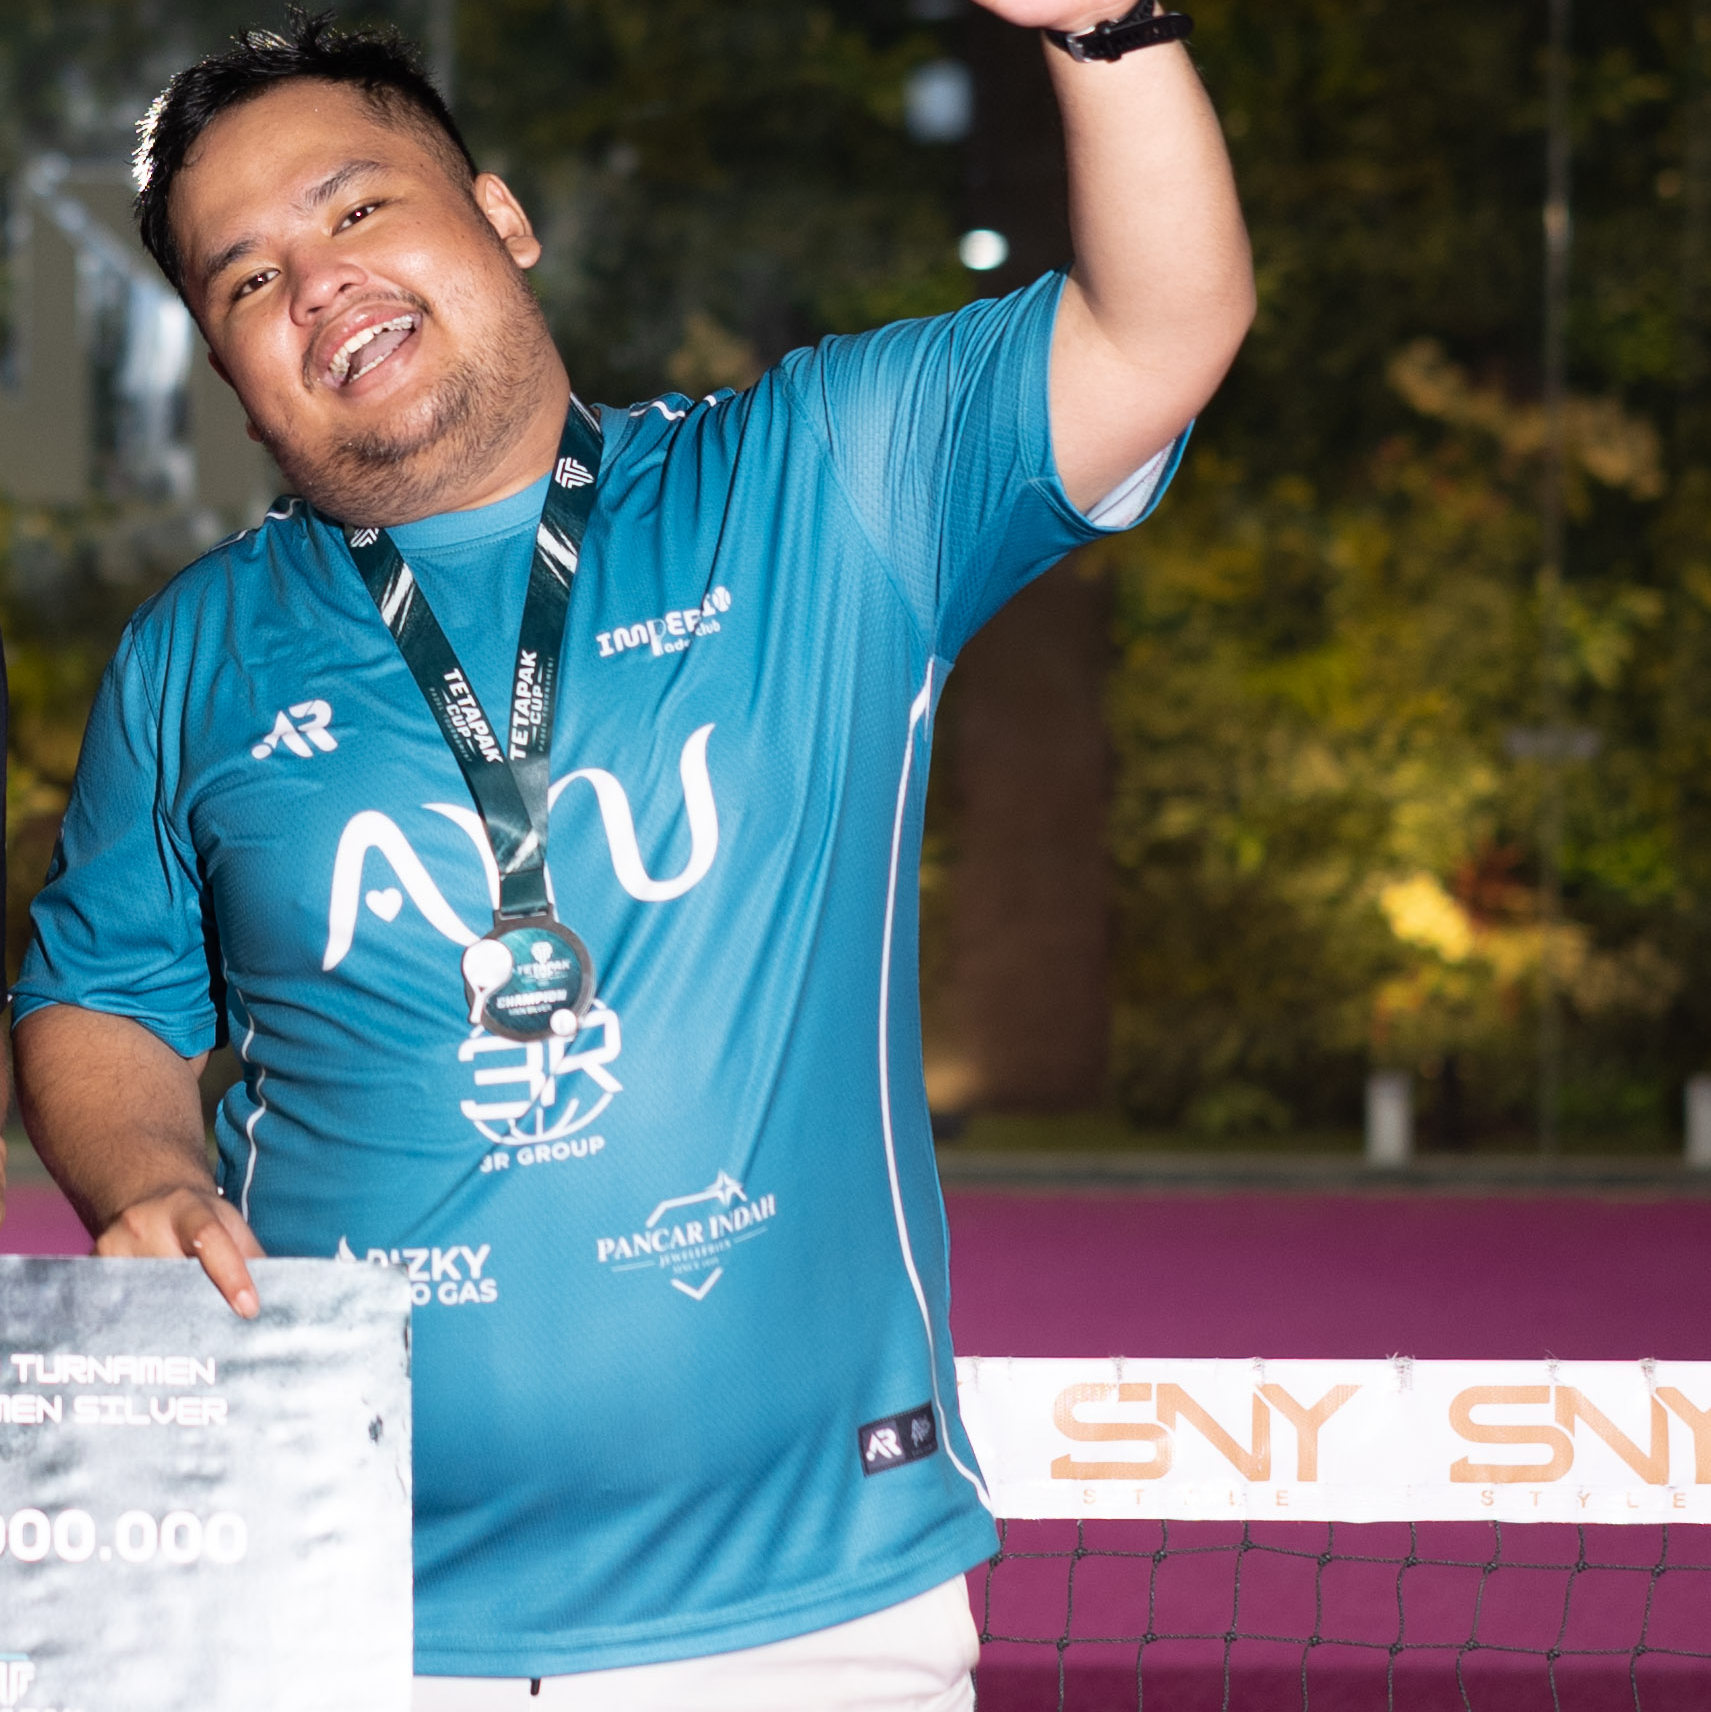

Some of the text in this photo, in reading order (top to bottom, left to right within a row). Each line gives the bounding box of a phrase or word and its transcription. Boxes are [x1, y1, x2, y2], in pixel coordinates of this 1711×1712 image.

[443, 668, 504, 763] TETAPAK
[510, 649, 537, 761] TETAPAK
[530, 684, 544, 725] CUP
[446, 704, 472, 739] CUP
[496, 989, 567, 1009] CHAMPION
[517, 1135, 605, 1166] GROUP
[596, 1193, 777, 1263] PANCAR INDAH
[439, 1278, 498, 1305] GAS
[10, 1353, 215, 1385] TURNAMEN
[73, 1395, 228, 1426] SILVER
[1050, 1382, 1363, 1482] SNY
[1083, 1488, 1289, 1506] STLE
[1480, 1489, 1686, 1509] STYLE
